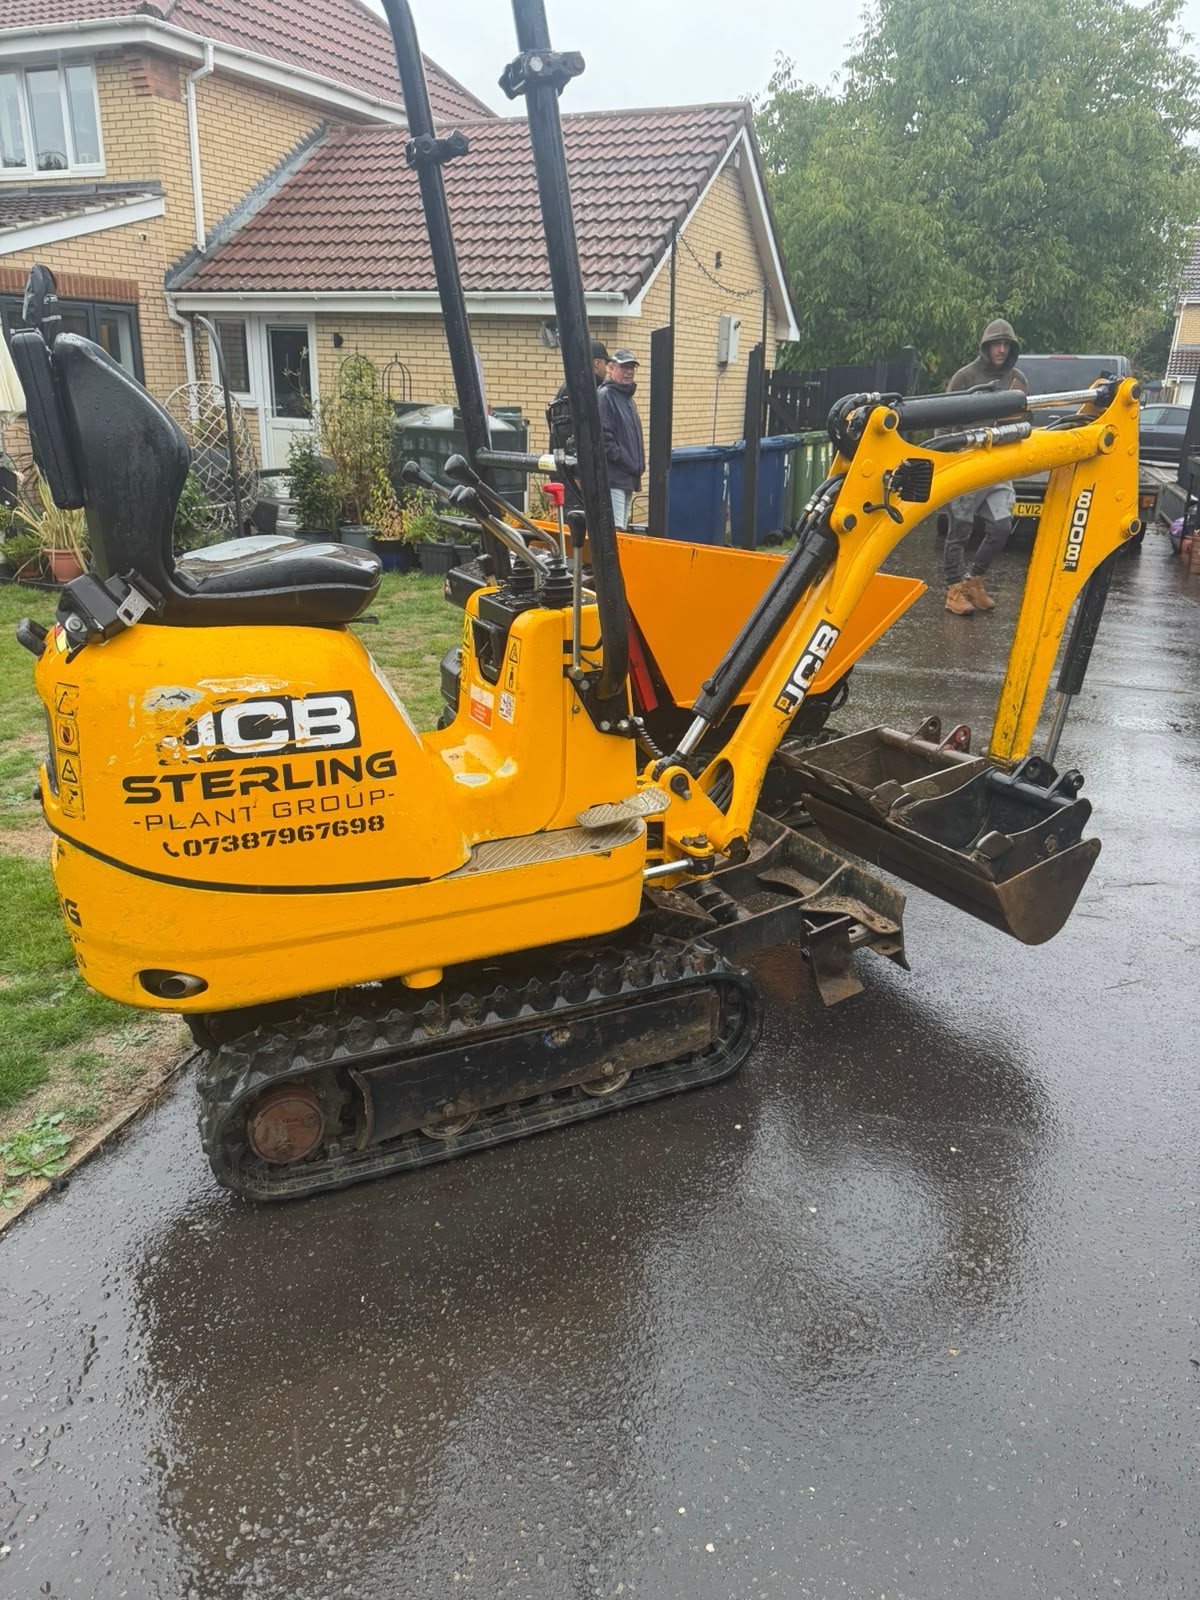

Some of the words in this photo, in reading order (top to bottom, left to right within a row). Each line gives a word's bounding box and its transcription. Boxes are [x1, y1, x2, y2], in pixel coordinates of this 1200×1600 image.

[1018, 504, 1041, 515] CV12
[1065, 491, 1092, 560] 8008
[785, 625, 839, 712] JCB
[122, 750, 398, 804] STERLING
[183, 815, 386, 857] 07387967698
